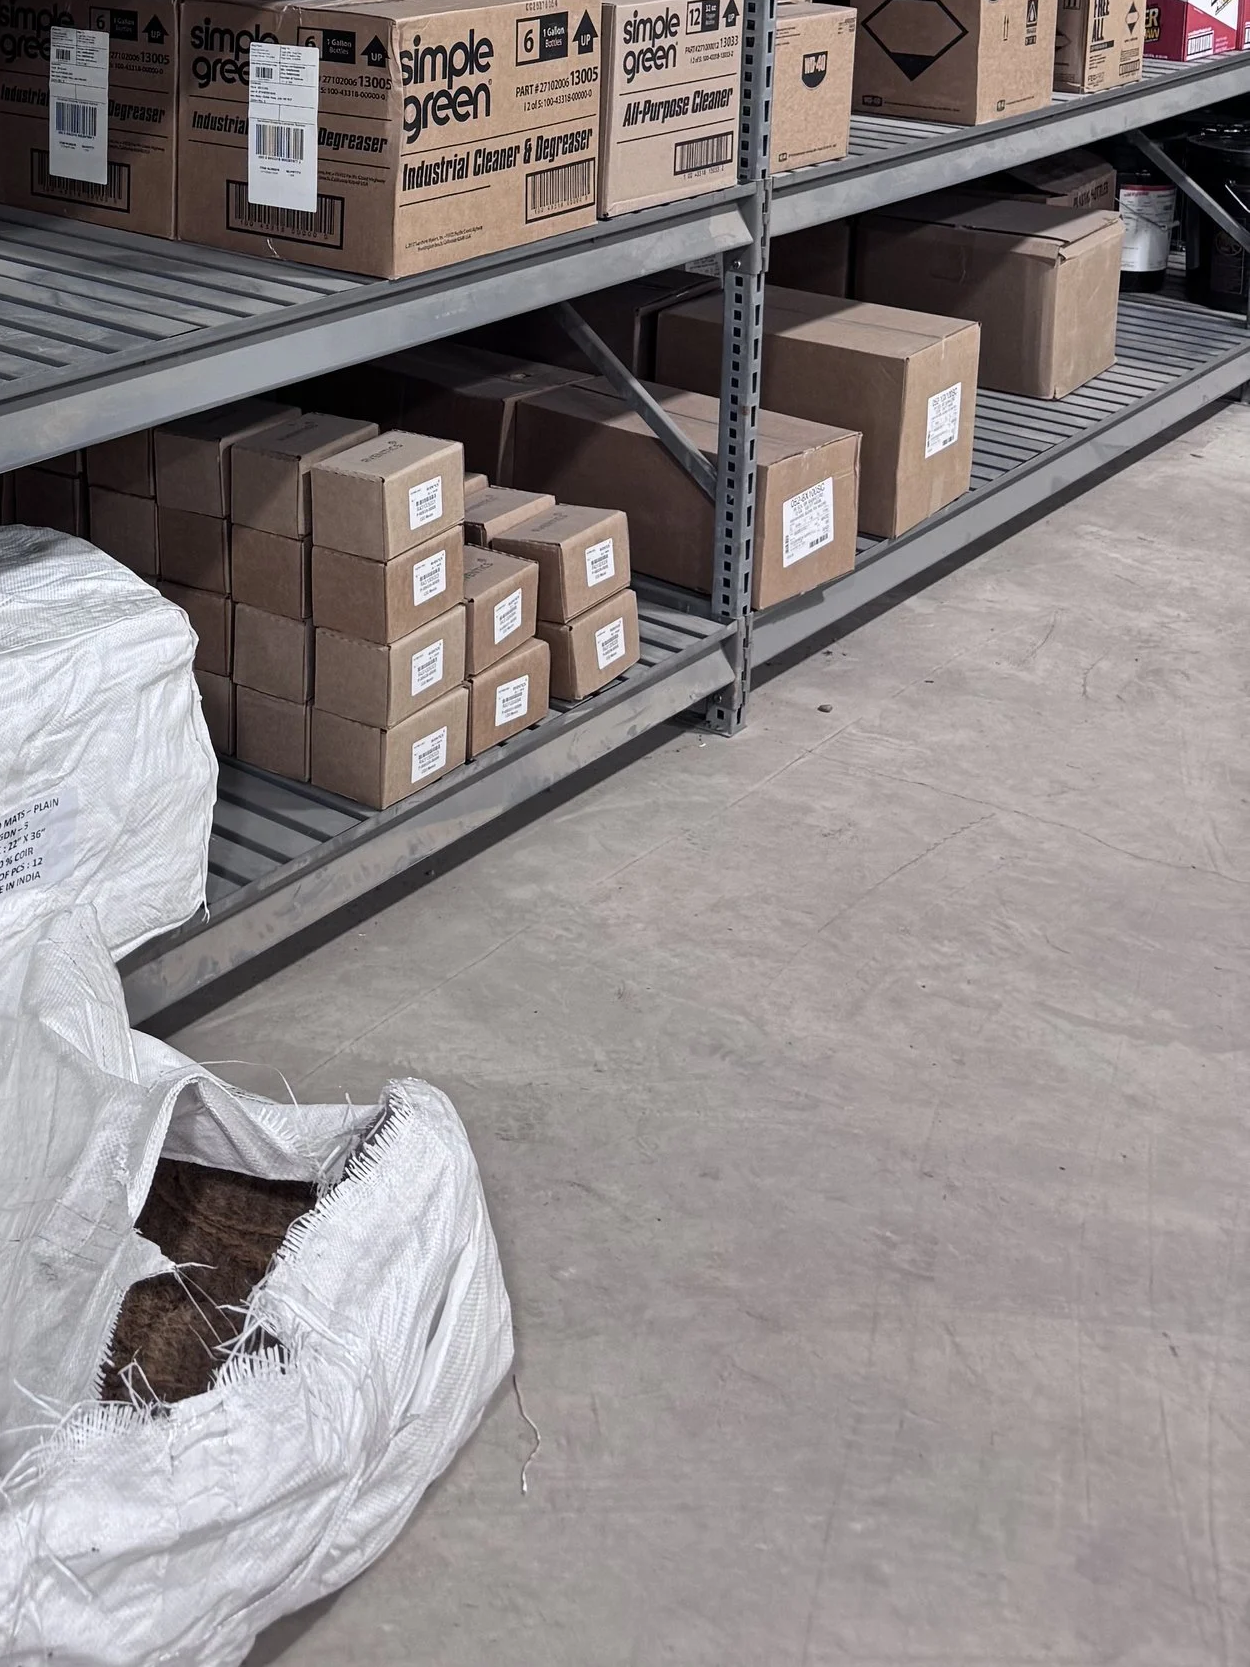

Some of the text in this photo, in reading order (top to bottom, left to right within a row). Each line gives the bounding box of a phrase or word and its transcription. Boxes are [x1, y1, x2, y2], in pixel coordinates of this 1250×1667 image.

[622, 7, 681, 48] simple
[688, 8, 700, 27] 12
[1092, 18, 1104, 42] ALL
[523, 29, 534, 53] 6
[581, 34, 591, 47] UP
[720, 35, 739, 50] 13033
[400, 28, 494, 90] simple
[622, 43, 677, 84] green
[570, 66, 598, 85] 13005
[403, 81, 491, 145] green
[623, 87, 734, 128] All-Purpose Cleaner
[403, 128, 593, 191] Industrial Cleaner & Degreaser
